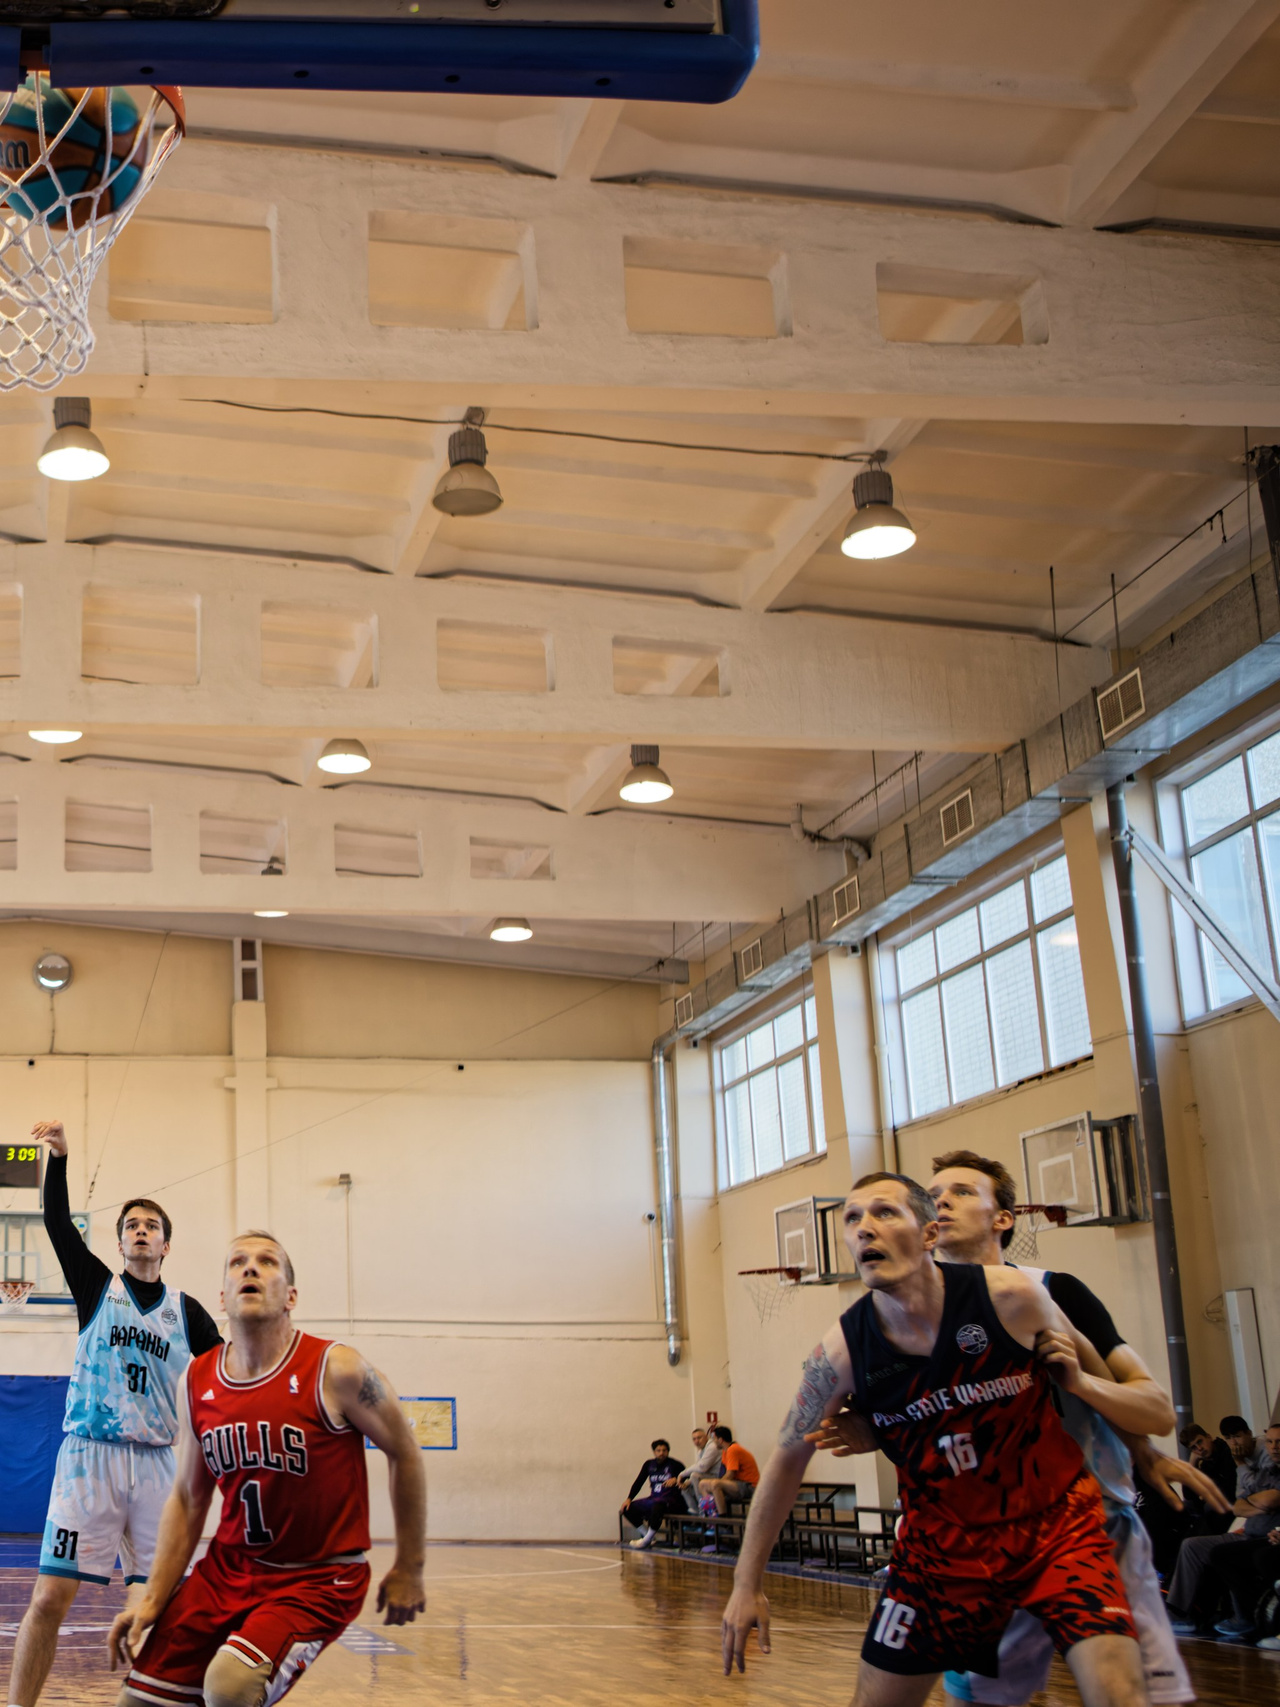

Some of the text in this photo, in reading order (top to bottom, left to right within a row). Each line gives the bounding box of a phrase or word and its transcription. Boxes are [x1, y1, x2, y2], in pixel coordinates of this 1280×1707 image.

[109, 1325, 171, 1363] ВАРАНЫ
[127, 1362, 147, 1395] 31
[905, 1388, 954, 1421] STATE
[201, 1421, 308, 1479] BULLS
[937, 1432, 978, 1477] 16
[240, 1480, 274, 1546] 1
[53, 1527, 79, 1561] 31
[873, 1597, 917, 1650] 16
